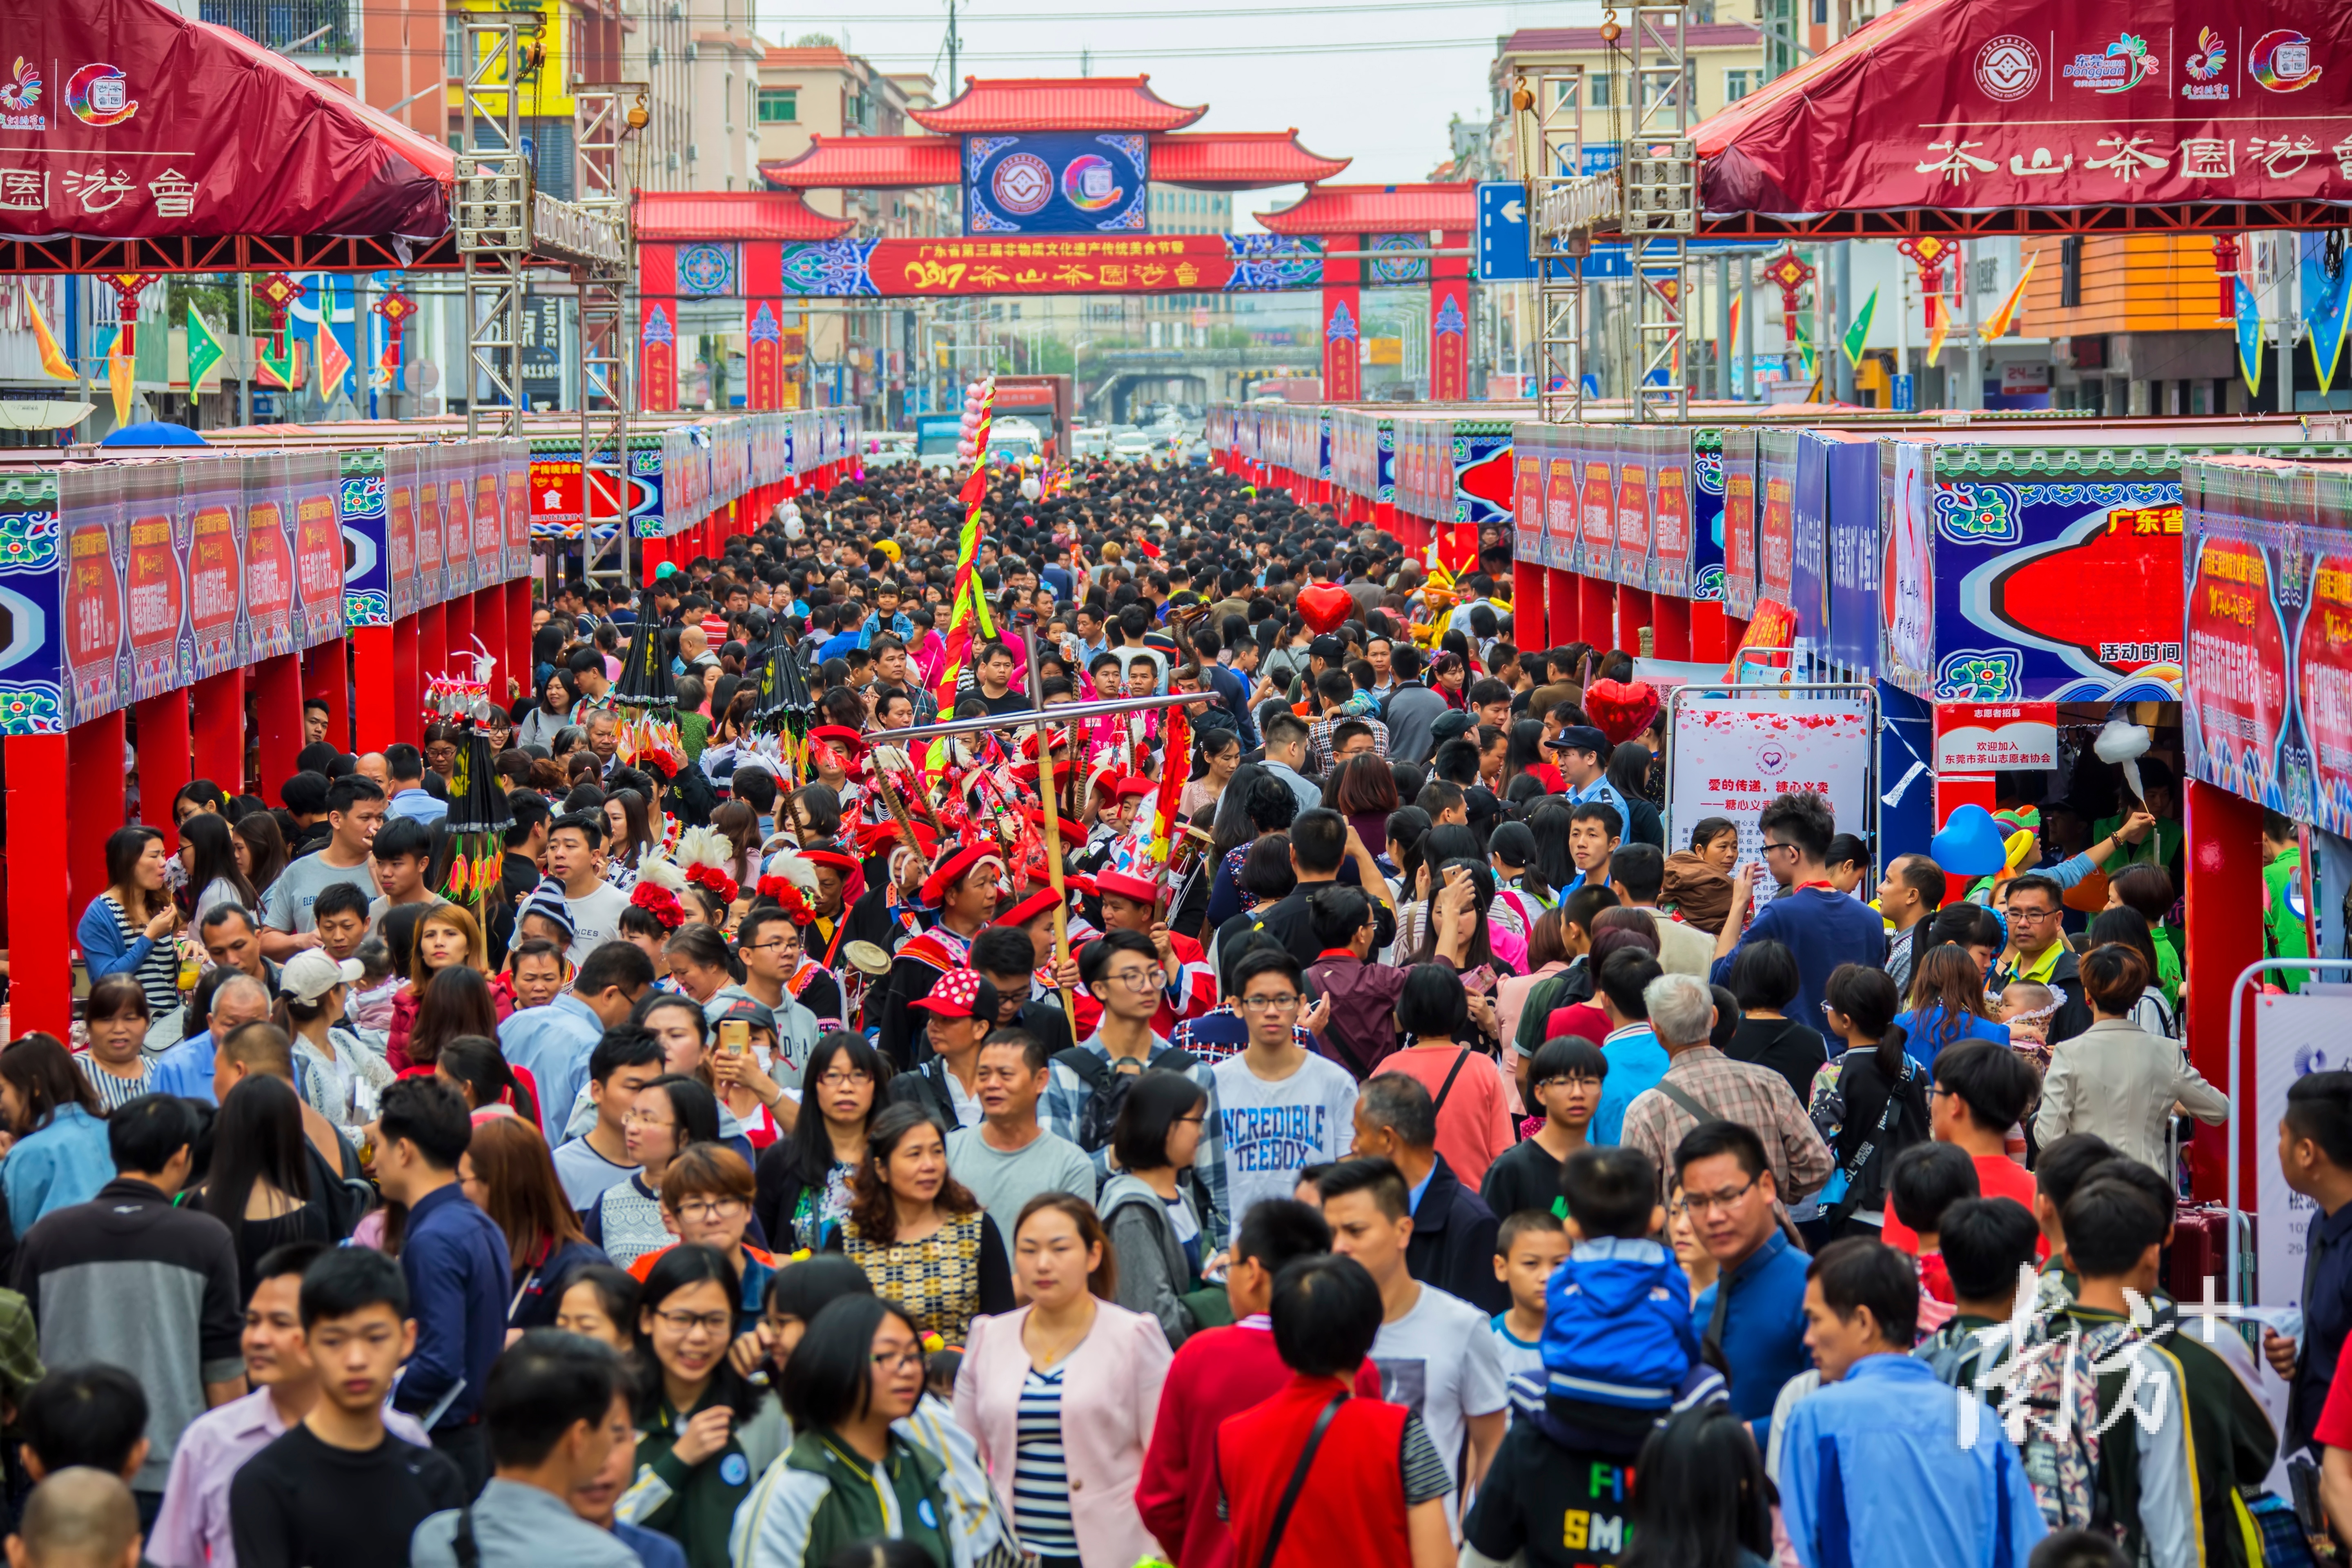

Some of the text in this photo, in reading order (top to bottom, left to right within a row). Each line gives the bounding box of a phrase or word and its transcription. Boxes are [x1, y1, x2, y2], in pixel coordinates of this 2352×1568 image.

[2075, 54, 2104, 67] 东莞
[2063, 65, 2125, 78] Dongguan
[543, 490, 562, 510] 食
[2108, 509, 2183, 535] 广东省
[2099, 642, 2181, 662] 活动时间
[1974, 708, 2021, 718] 志愿者招募
[1977, 741, 2019, 751] 欢迎加入
[1945, 753, 2051, 764] 东莞市茶山志愿者协会
[1223, 1105, 1325, 1153] NCREDIBLE
[1235, 1140, 1308, 1172] TEEBOX
[1853, 1140, 1869, 1163] LIMITED
[1857, 1143, 1875, 1167] EDITION
